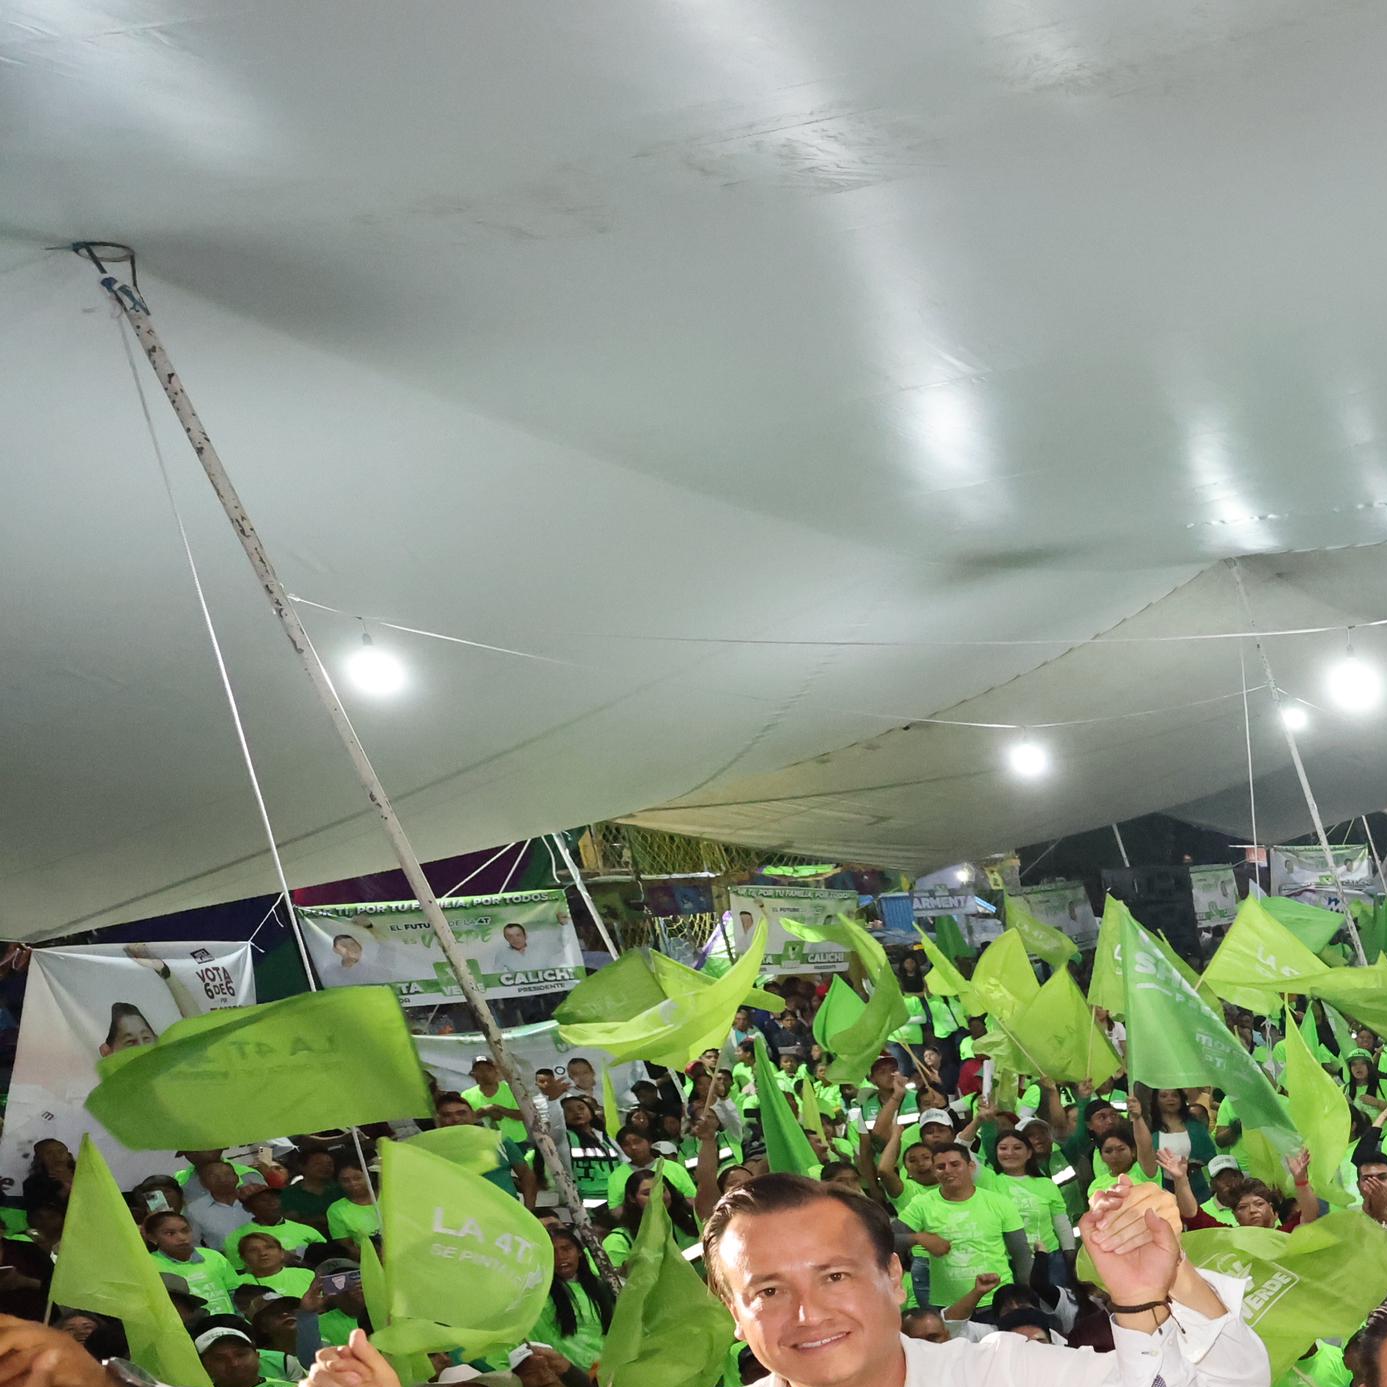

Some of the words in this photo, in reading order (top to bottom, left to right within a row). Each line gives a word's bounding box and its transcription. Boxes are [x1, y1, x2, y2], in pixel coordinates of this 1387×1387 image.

[356, 904, 385, 915] POR
[389, 902, 413, 913] TU
[472, 896, 502, 907] POR
[404, 922, 432, 931] FUTU
[807, 953, 845, 963] CALICHI
[196, 966, 234, 983] VOTA
[517, 983, 566, 994] PRESIDENTE
[432, 1207, 486, 1244] LA
[495, 1231, 535, 1264] 4T
